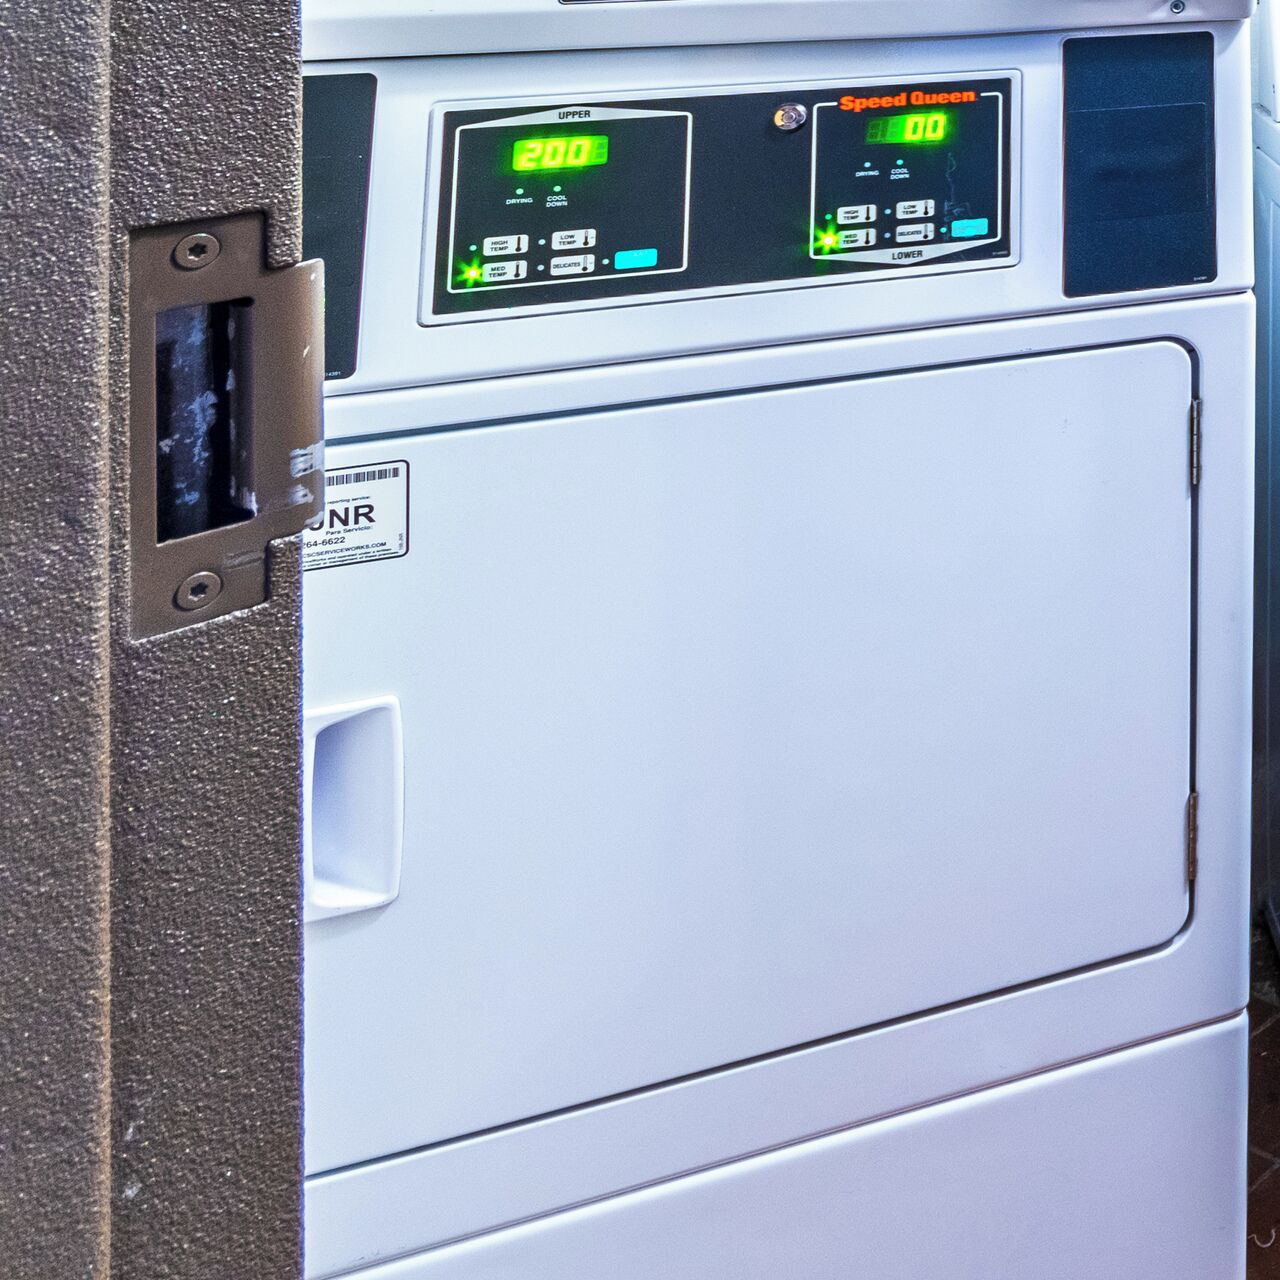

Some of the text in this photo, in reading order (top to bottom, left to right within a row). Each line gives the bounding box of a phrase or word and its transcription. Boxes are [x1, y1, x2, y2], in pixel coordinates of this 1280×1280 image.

[839, 90, 977, 112] Speed Queen
[558, 109, 591, 120] UPPER
[903, 113, 947, 141] 00
[506, 196, 533, 205] DRYING
[546, 200, 568, 208] DOWN
[892, 250, 923, 261] LOWER
[552, 261, 581, 270] DELICATES
